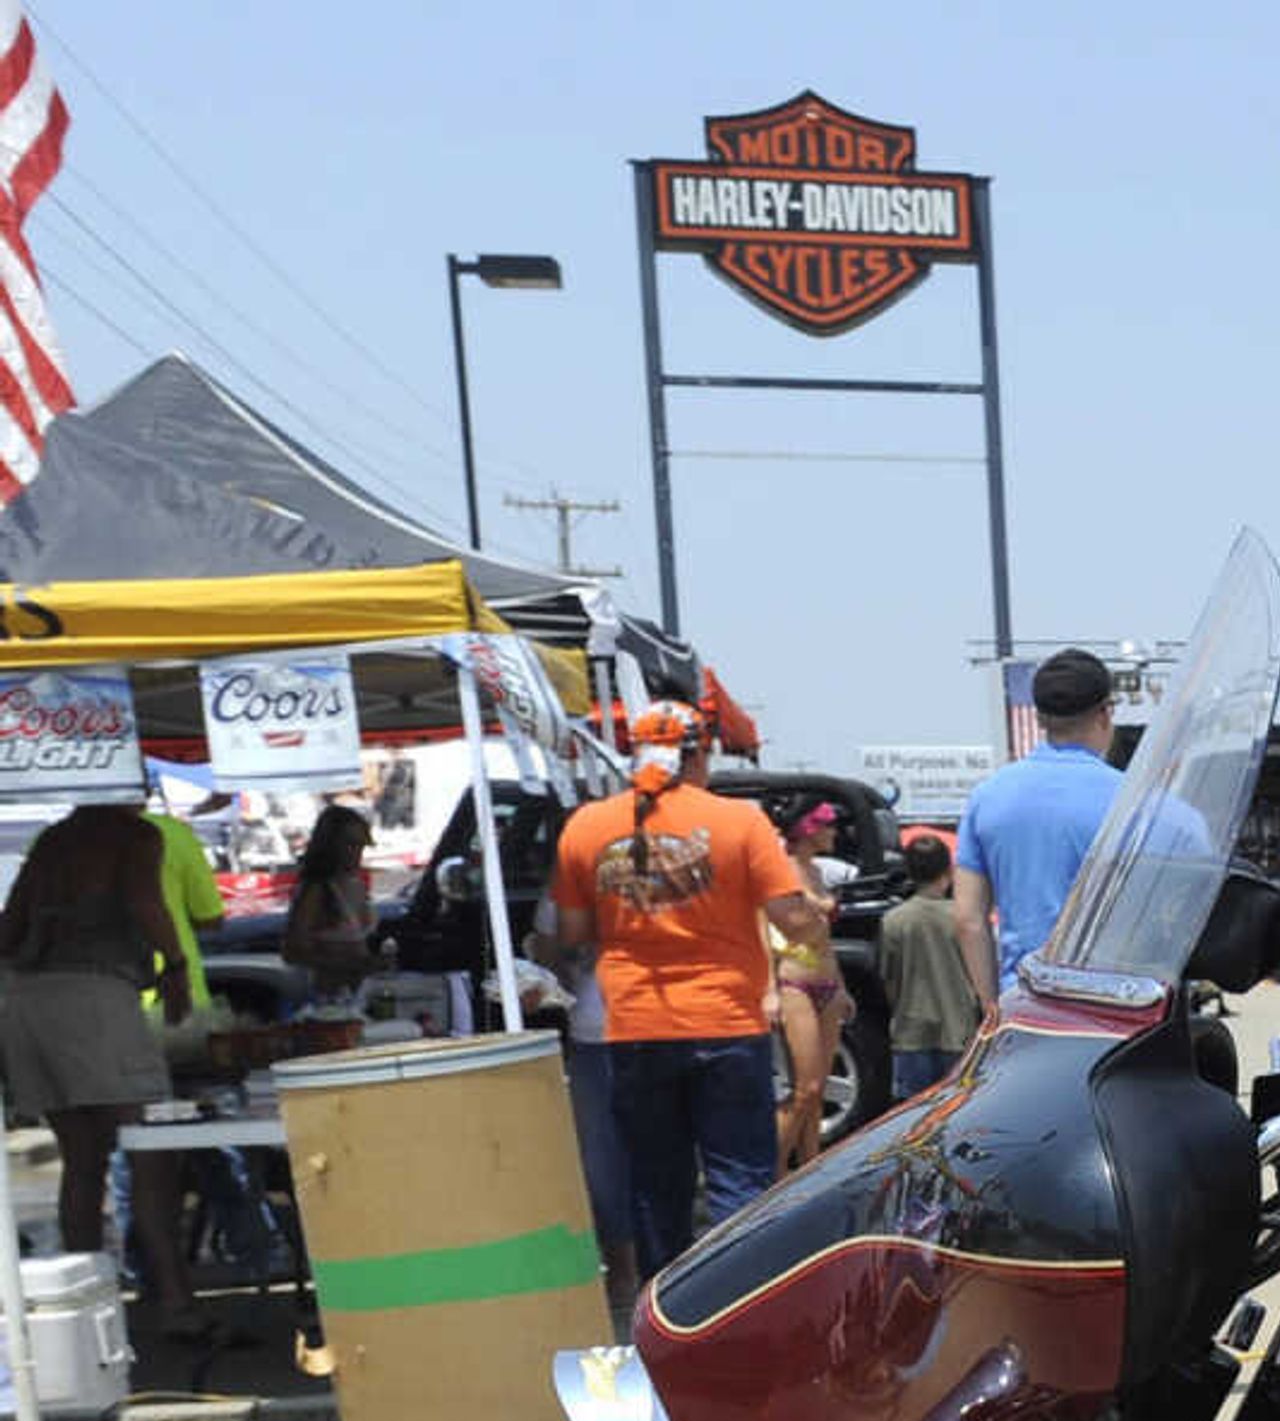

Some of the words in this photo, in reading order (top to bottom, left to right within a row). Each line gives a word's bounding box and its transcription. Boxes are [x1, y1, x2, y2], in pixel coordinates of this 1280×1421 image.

[739, 121, 887, 170] MOTOR
[672, 176, 957, 236] HARLEY-DAVIDSON
[744, 244, 891, 307] CYCLES
[0, 687, 123, 737] Coors
[210, 674, 345, 723] Coors
[0, 739, 125, 771] LIGHT
